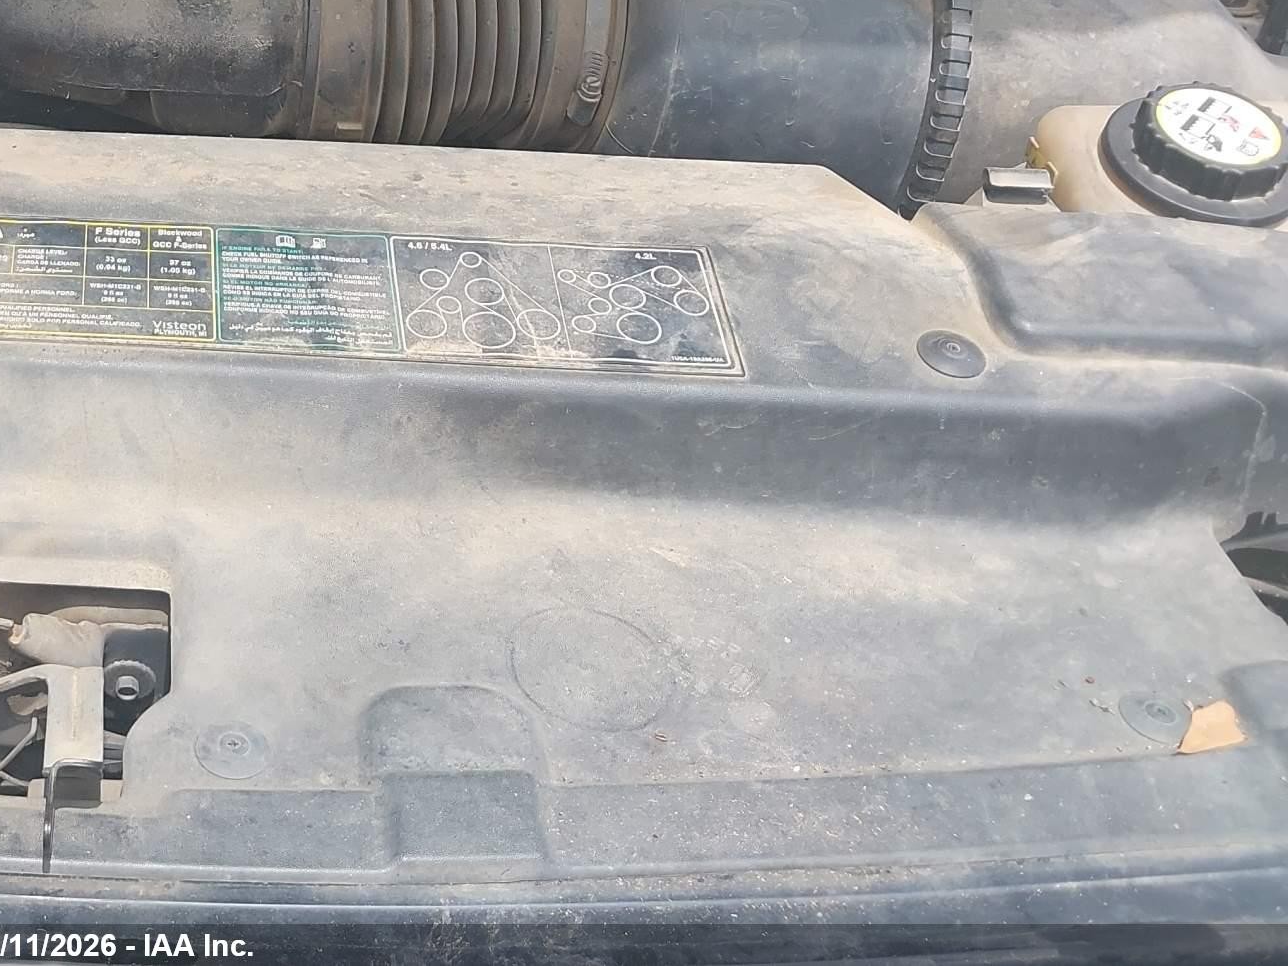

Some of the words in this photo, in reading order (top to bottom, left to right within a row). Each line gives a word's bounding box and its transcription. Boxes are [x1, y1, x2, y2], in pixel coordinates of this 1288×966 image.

[95, 227, 103, 235] F
[105, 227, 141, 237] Series
[408, 241, 422, 250] 4.6
[431, 242, 453, 251] 5.4L
[152, 320, 207, 331] Visteon
